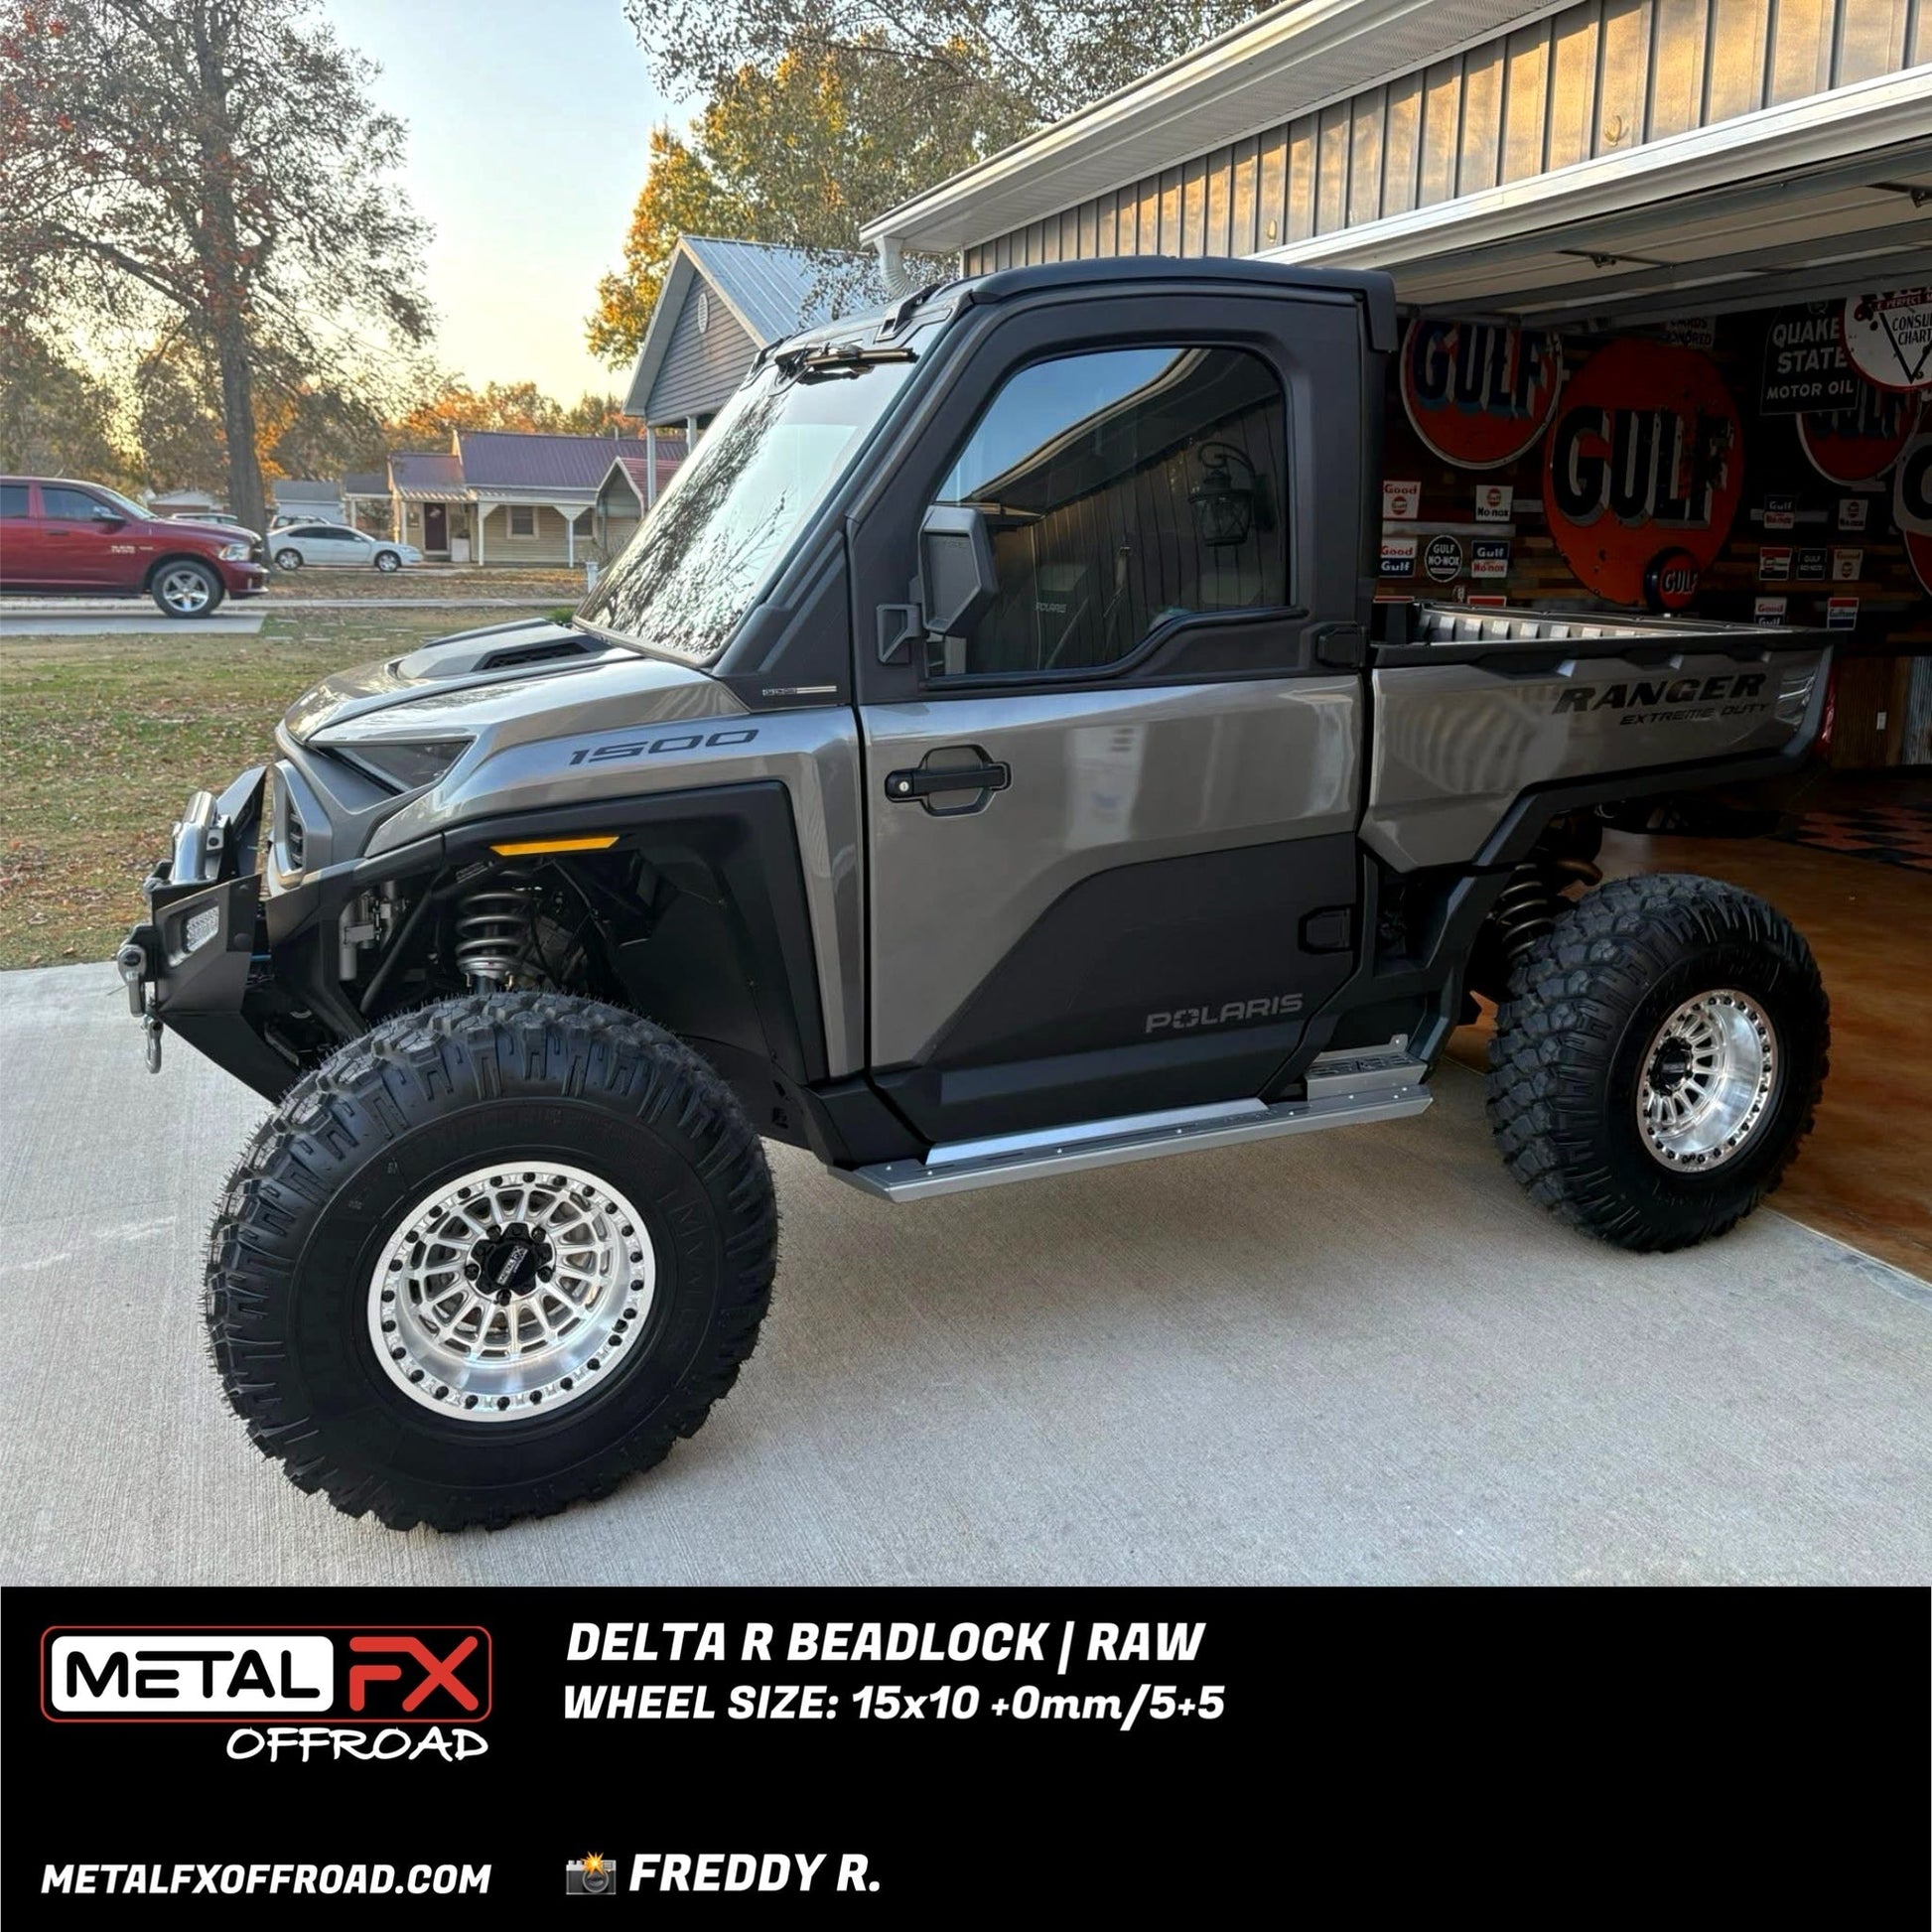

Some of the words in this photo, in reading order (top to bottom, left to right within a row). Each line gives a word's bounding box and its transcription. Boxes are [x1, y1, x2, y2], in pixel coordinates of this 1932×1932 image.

[1772, 316, 1841, 348] QUAKE
[1897, 328, 1932, 345] CHART
[1776, 347, 1849, 375] STATE
[1766, 381, 1824, 401] MOTOR
[1828, 377, 1855, 395] OIL
[1552, 405, 1734, 529] GULF
[1385, 483, 1418, 494] Good
[1381, 545, 1413, 556] Good
[1433, 543, 1456, 554] GULF
[1476, 546, 1505, 558] Gulf
[1380, 560, 1411, 572] Gulf
[1664, 569, 1701, 596] GULF
[1552, 673, 1766, 715] RANGER
[1619, 707, 1716, 726] EXTREME
[1720, 703, 1770, 717] DUTY
[569, 729, 759, 765] 1500
[1146, 993, 1304, 1034] POLARIS
